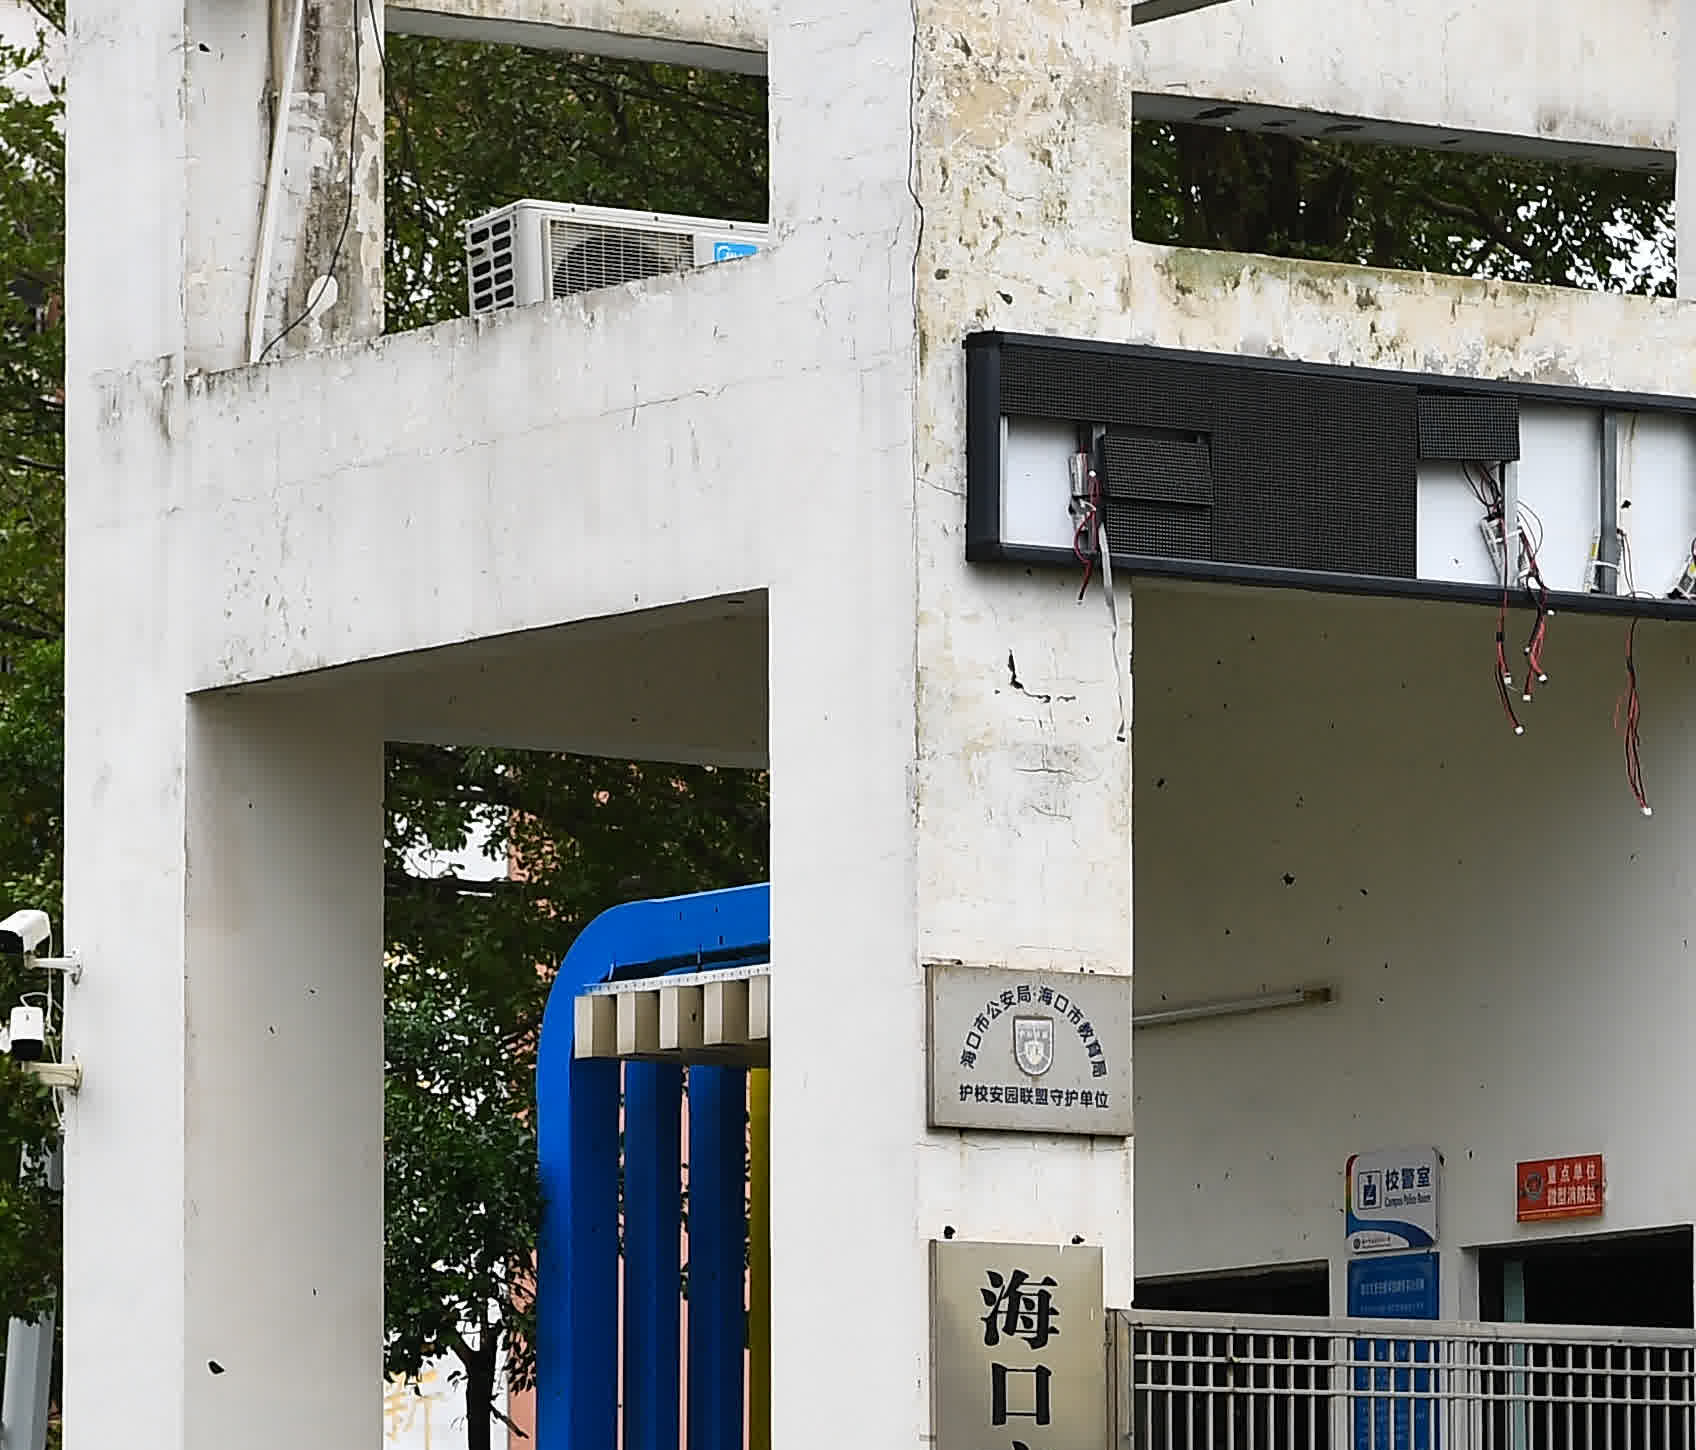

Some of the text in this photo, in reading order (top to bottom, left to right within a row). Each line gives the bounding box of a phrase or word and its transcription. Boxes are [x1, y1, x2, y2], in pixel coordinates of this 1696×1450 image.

[959, 1084, 1109, 1109] 护校安园联盟守护单位
[1384, 1166, 1431, 1191] 校警室
